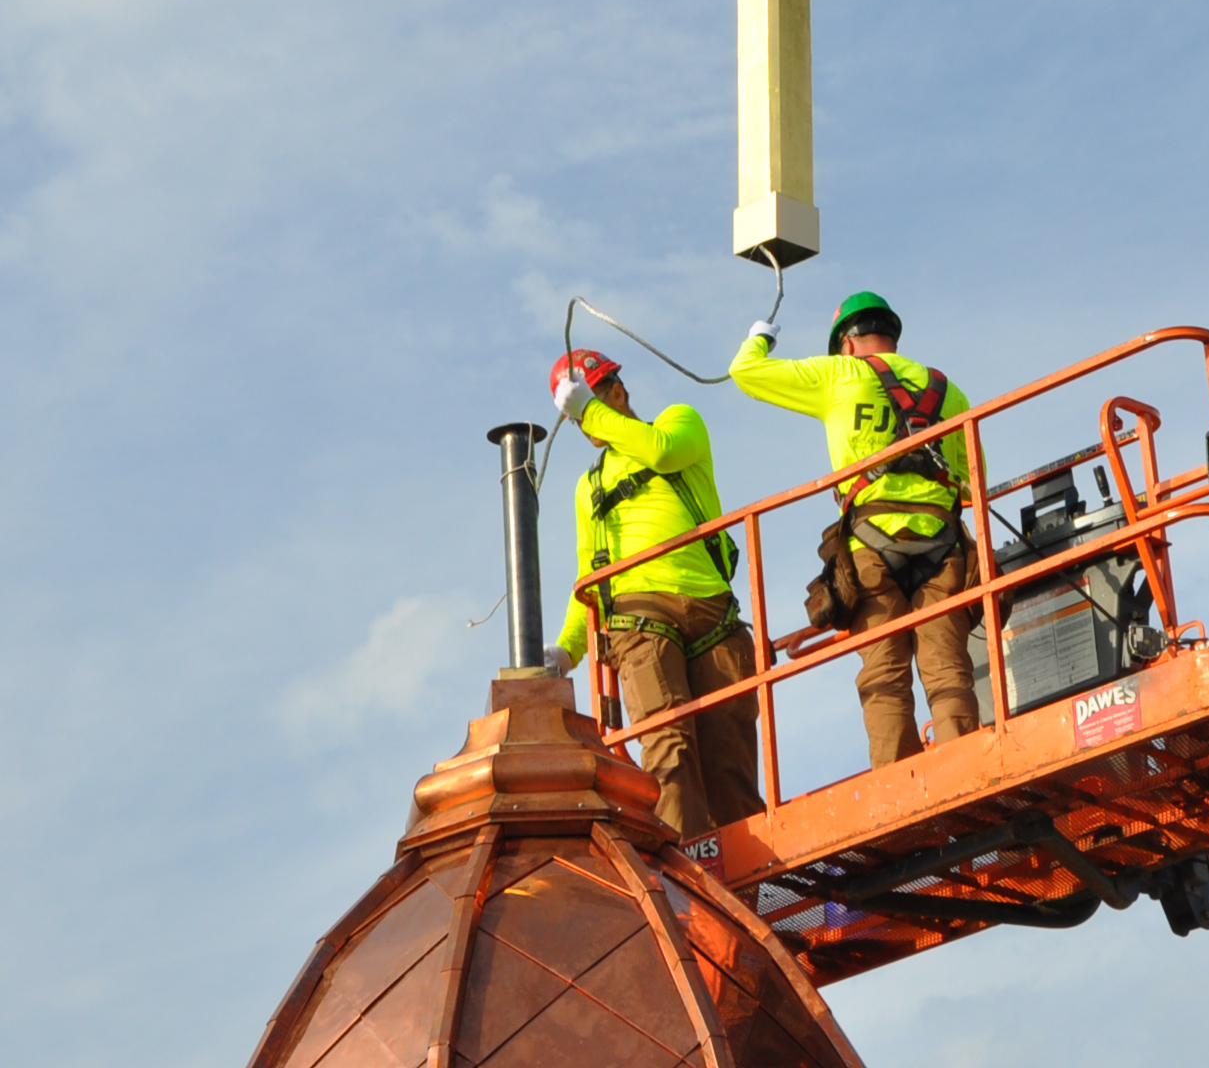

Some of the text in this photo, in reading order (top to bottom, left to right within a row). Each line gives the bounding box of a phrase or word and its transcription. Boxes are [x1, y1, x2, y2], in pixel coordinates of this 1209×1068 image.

[853, 402, 900, 434] FJ
[1075, 685, 1137, 727] DAWES
[684, 836, 719, 861] WES
